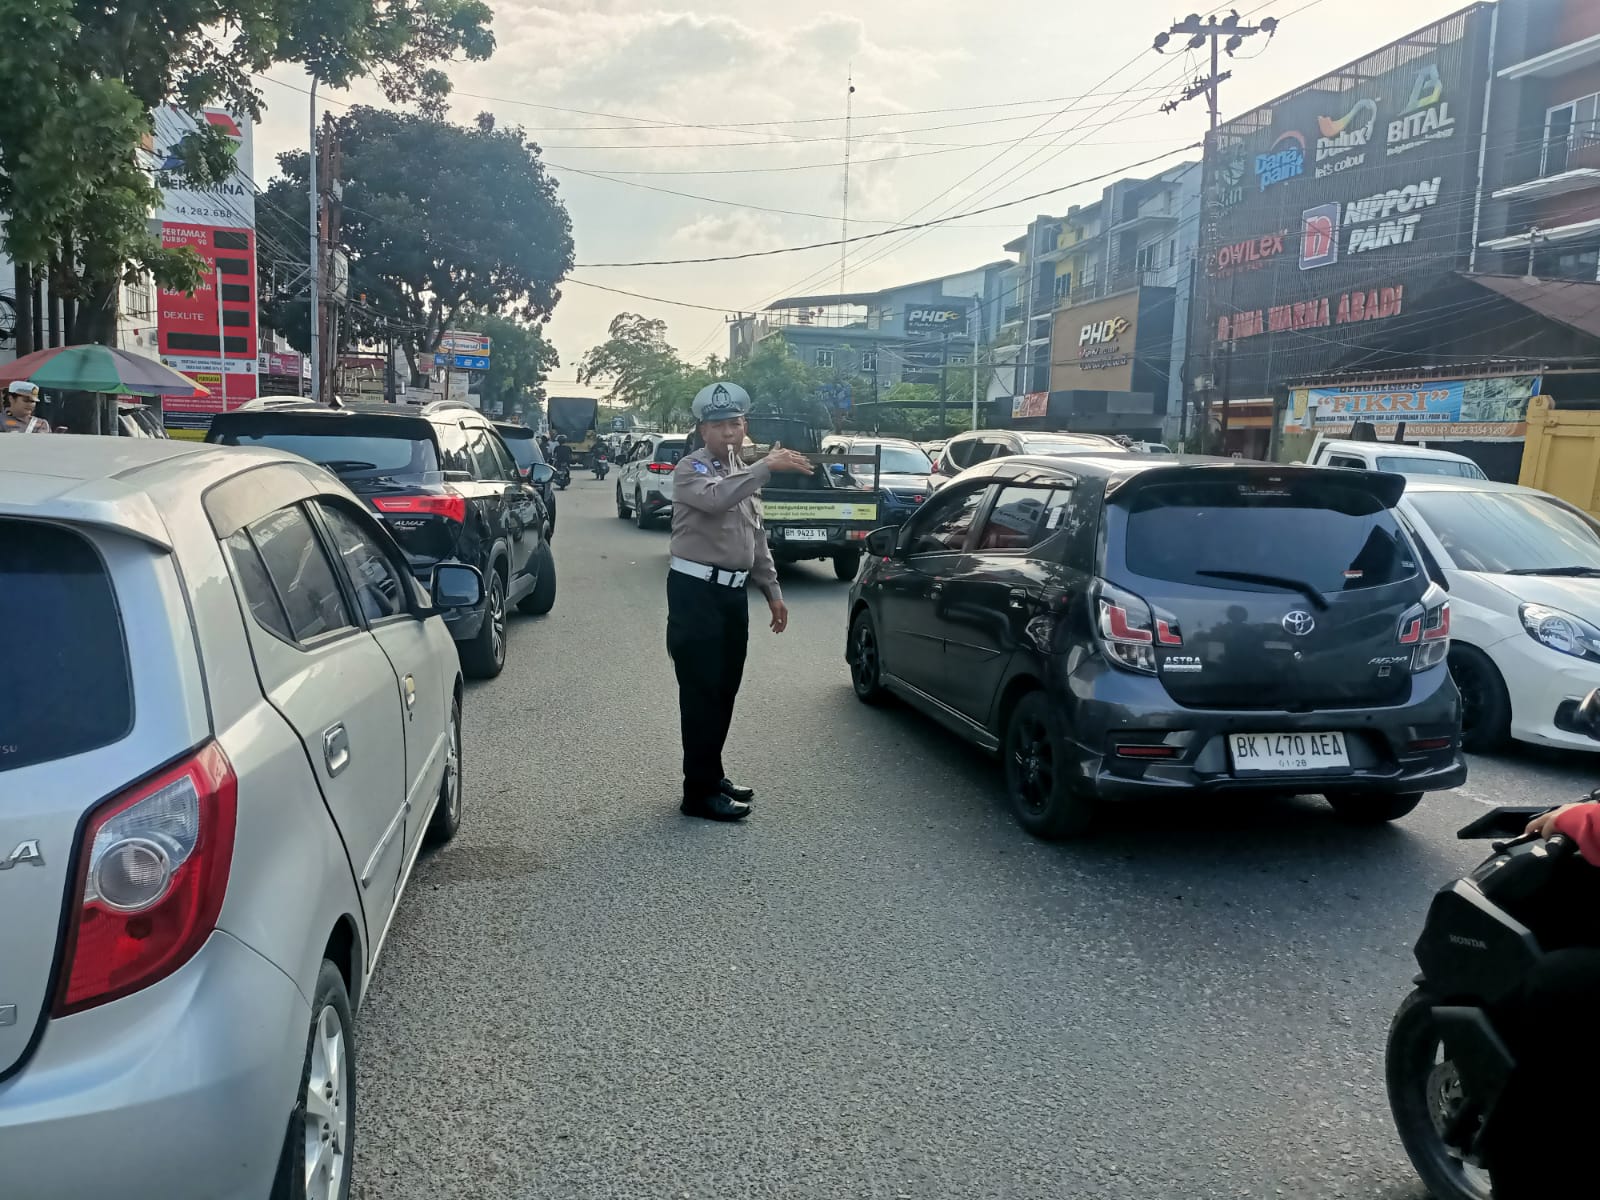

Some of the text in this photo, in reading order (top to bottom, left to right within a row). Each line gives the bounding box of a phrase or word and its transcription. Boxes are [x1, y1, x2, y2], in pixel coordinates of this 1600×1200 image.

[1387, 102, 1456, 143] BITAL
[1315, 127, 1368, 163] Dulux
[1255, 148, 1298, 174] Dana
[1334, 154, 1366, 173] colour
[1259, 155, 1303, 193] paint
[1343, 176, 1442, 225] NIPPON
[162, 227, 207, 239] PERTAMAX
[1347, 213, 1422, 255] PAINT
[163, 310, 205, 322] DEXLITE
[908, 310, 946, 323] PHD
[1267, 297, 1330, 332] WARNA
[1335, 284, 1404, 325] ABADI
[1078, 320, 1114, 347] PHD
[785, 528, 826, 537] BM 9423 TK
[1164, 655, 1202, 665] ASTRA
[1237, 734, 1343, 758] BK 1470 AEA
[1449, 933, 1488, 950] HONDA
